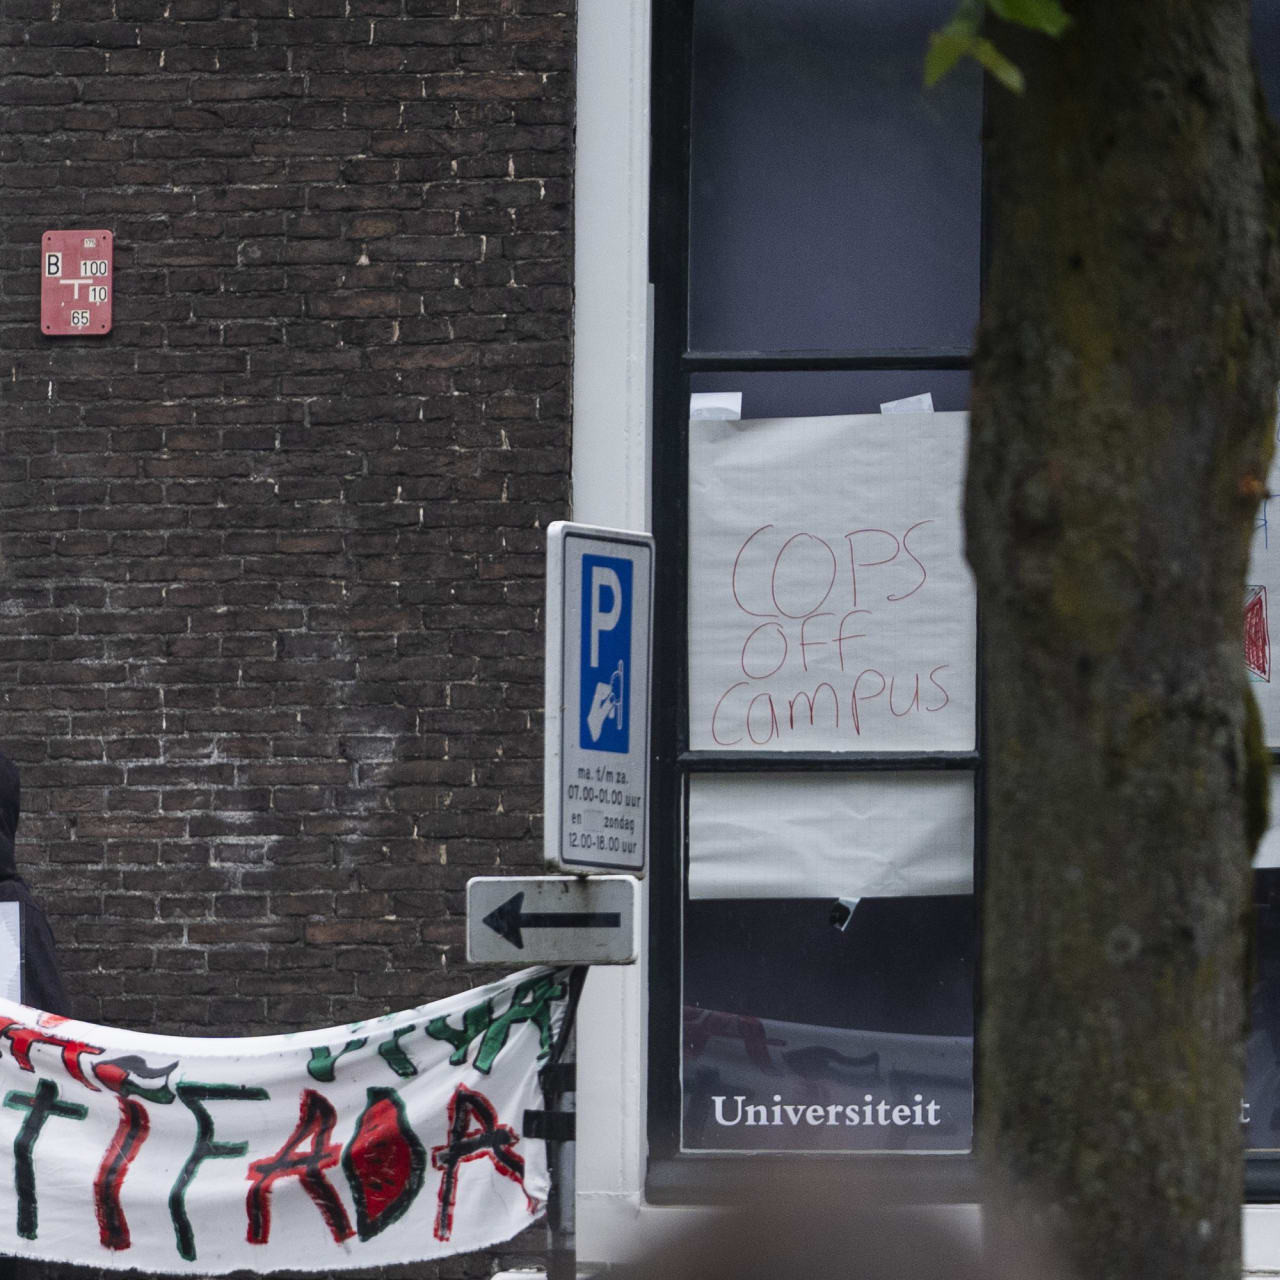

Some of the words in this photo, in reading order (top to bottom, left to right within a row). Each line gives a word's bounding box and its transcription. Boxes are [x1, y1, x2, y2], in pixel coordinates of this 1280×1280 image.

[48, 254, 60, 275] B
[82, 262, 107, 275] 100
[91, 287, 107, 301] 10
[72, 311, 88, 325] 65
[732, 519, 934, 619] COPS
[590, 565, 622, 668] P
[741, 609, 872, 679] OFF
[578, 767, 594, 780] ma.
[596, 766, 614, 783] t/m
[616, 772, 628, 784] za.
[568, 784, 623, 806] 07.00-01.00
[625, 797, 641, 807] uur
[572, 812, 582, 824] en
[604, 814, 635, 836] zondag
[568, 831, 620, 852] 12.00-18.00
[621, 841, 638, 854] uur
[711, 1094, 941, 1126] Universiteit
